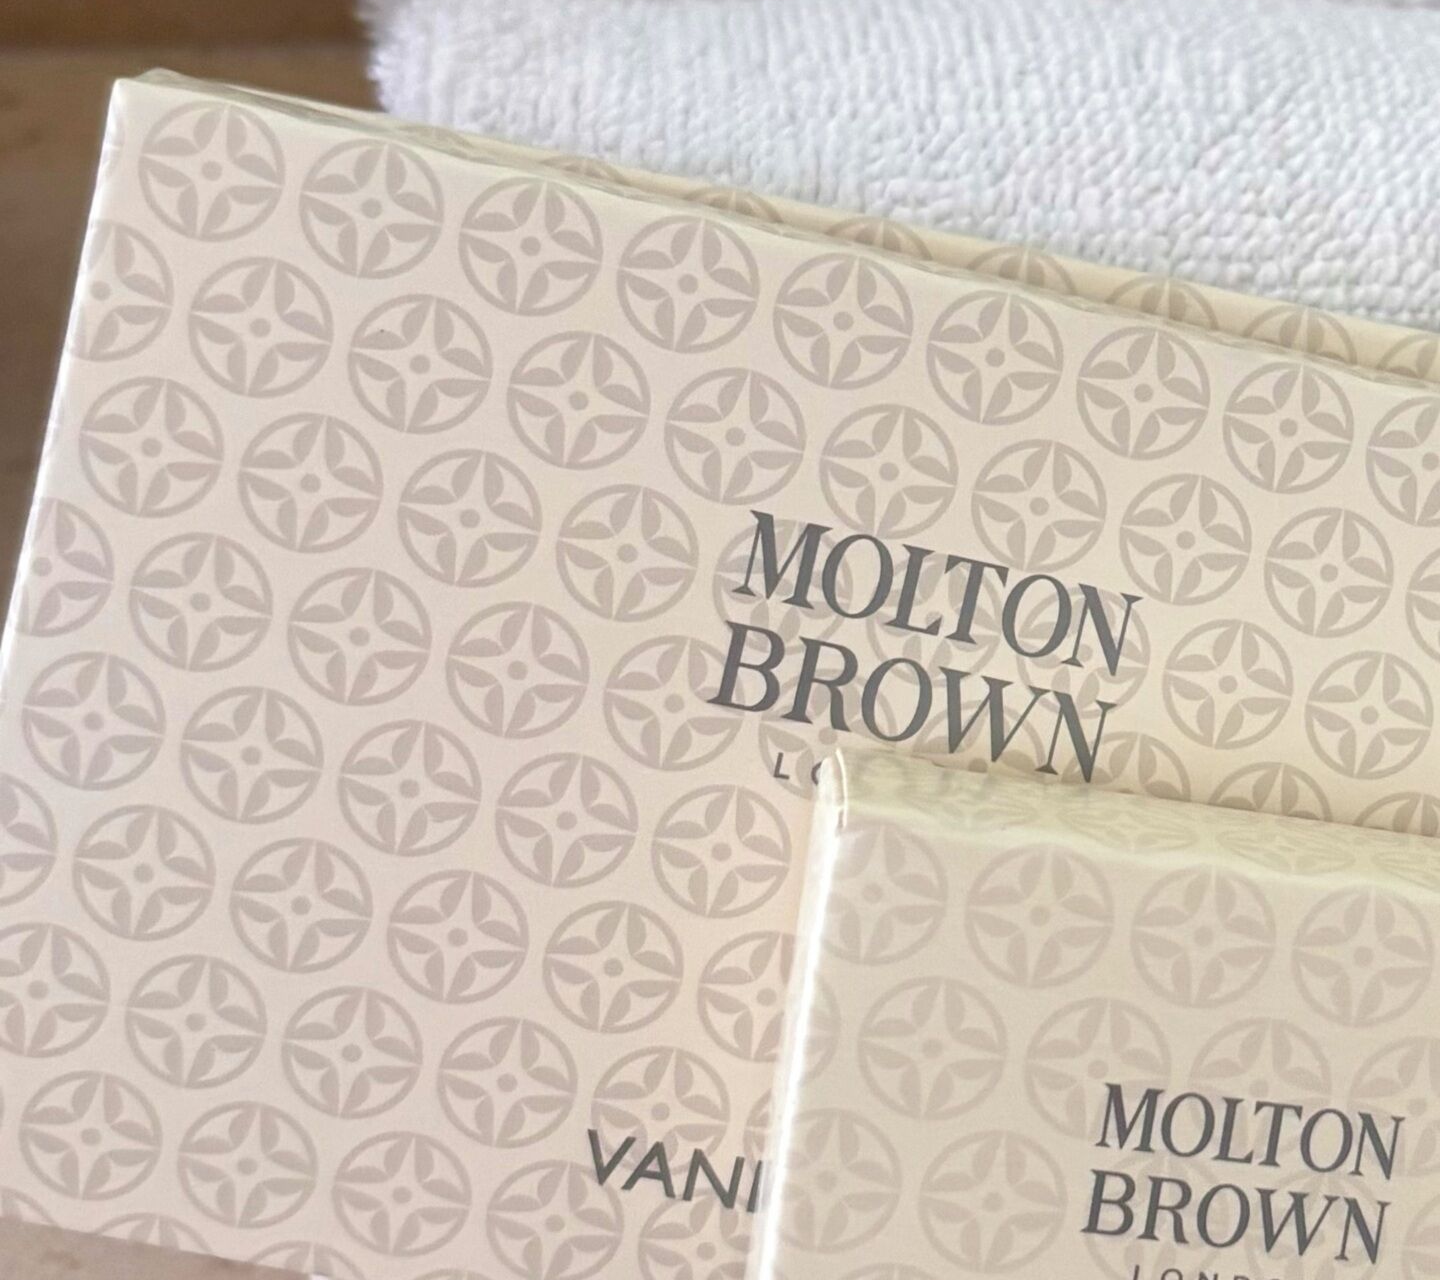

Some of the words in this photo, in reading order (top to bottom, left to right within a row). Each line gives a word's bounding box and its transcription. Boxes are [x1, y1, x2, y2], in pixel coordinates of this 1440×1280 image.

[731, 509, 1144, 677] MOLTON
[706, 619, 1117, 784] BROWN
[588, 1128, 763, 1213] VANI
[1095, 1082, 1406, 1180] MOLTON
[1080, 1168, 1391, 1265] BROWN
